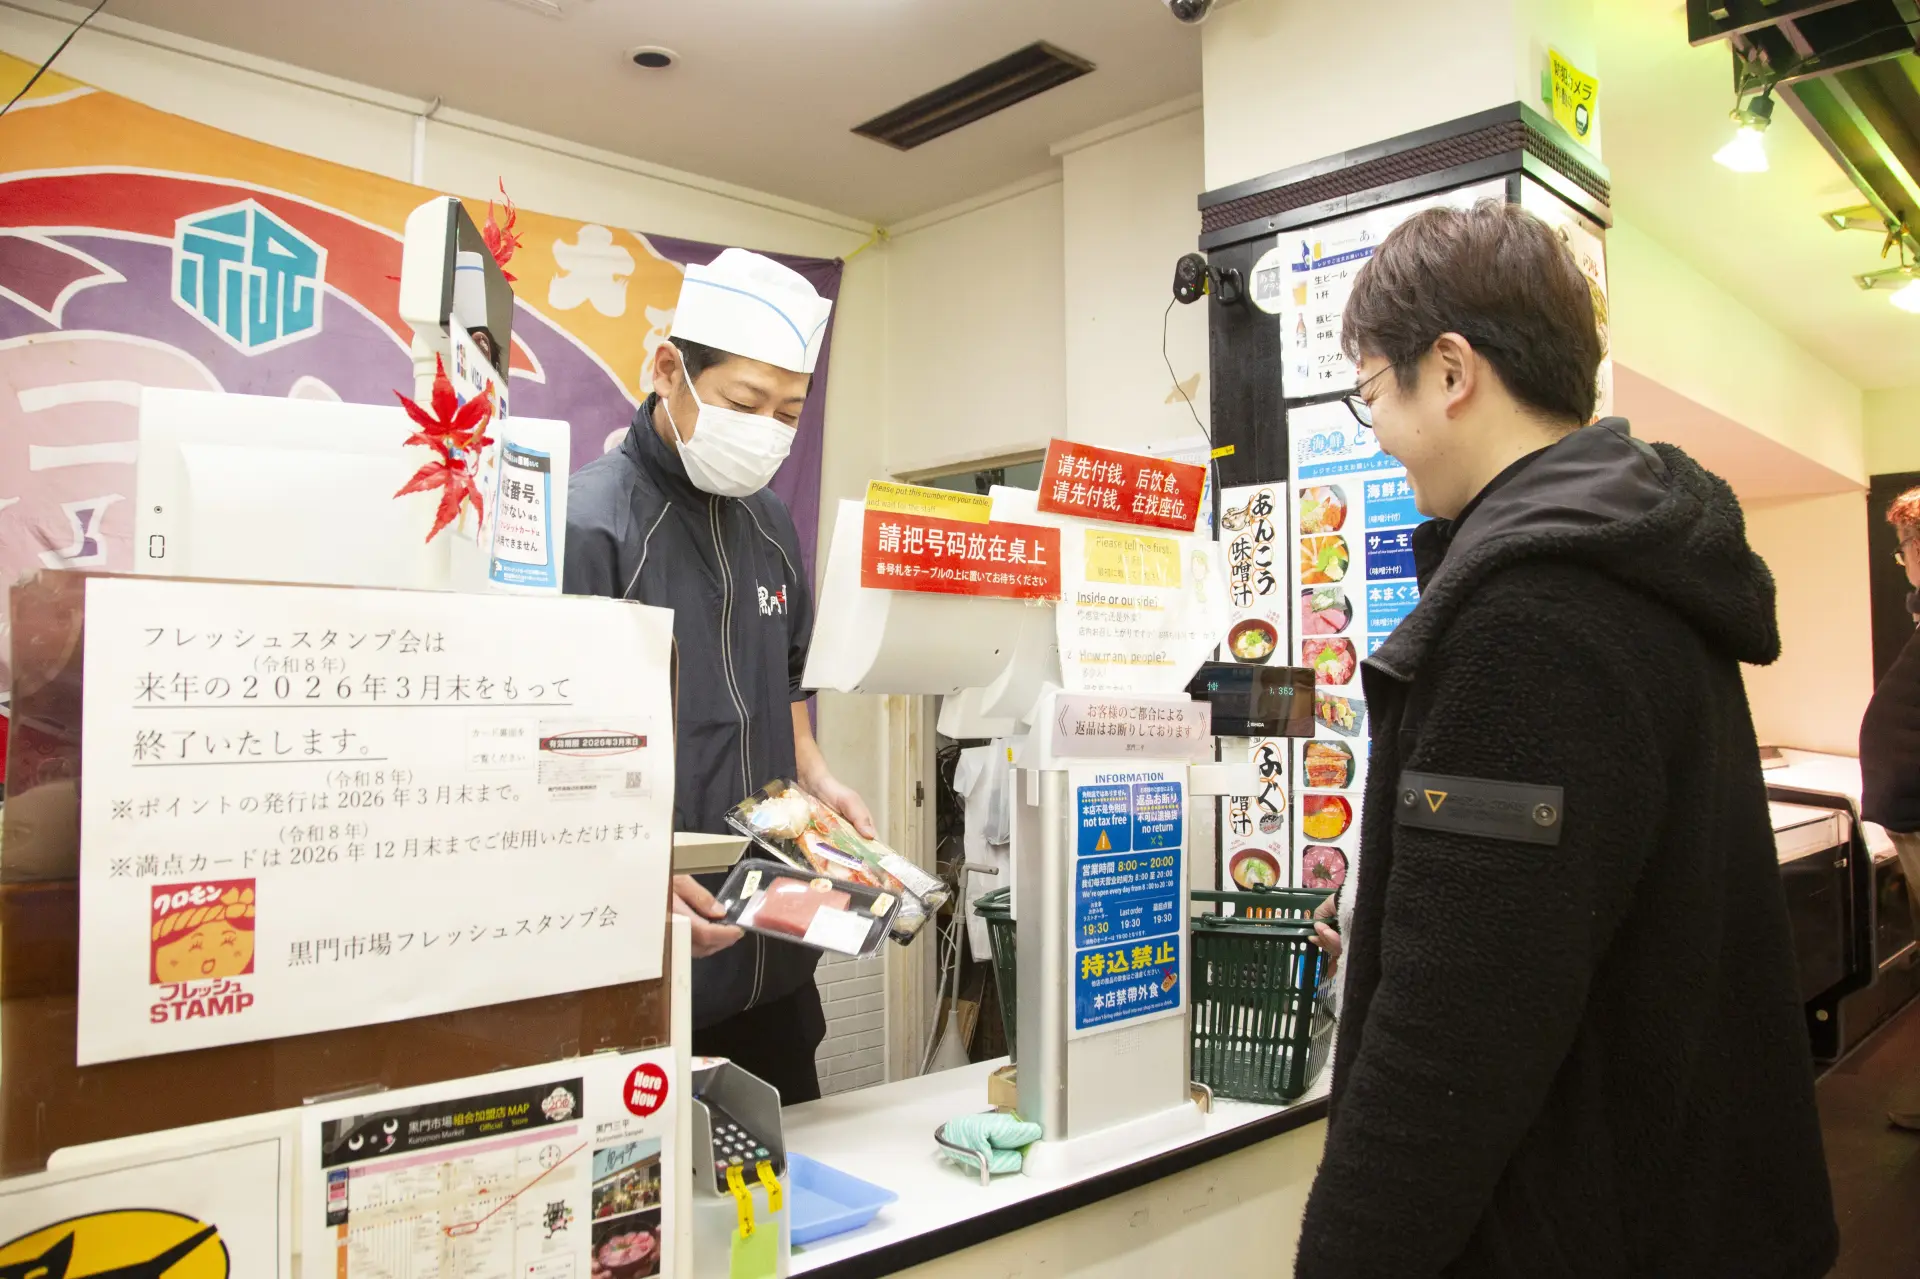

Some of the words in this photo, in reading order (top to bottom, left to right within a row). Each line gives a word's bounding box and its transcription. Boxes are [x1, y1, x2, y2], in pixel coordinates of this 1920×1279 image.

[1315, 271, 1348, 285] 生ビール
[1316, 290, 1329, 300] 1杯
[1319, 370, 1332, 379] 1本
[871, 483, 894, 493] Please
[896, 486, 908, 496] put
[908, 488, 921, 497] this
[923, 490, 946, 501] number
[957, 495, 971, 506] your
[866, 499, 880, 507] and
[881, 500, 896, 508] wait
[897, 501, 908, 509] for
[909, 502, 919, 510] the
[878, 522, 1047, 566] 請把号码放在桌上
[1096, 536, 1122, 549] Please
[1124, 538, 1137, 550] tell
[1153, 541, 1172, 554] first.
[1252, 493, 1275, 595] あんこう
[1368, 533, 1413, 550] サーモ
[876, 562, 1047, 587] 番号札をテーブルの上に置いてお待ちください
[1232, 537, 1252, 607] 味噌汁
[1369, 565, 1402, 575] (味噌汁付)
[1077, 591, 1106, 605] Inside
[1108, 595, 1118, 605] or
[144, 628, 447, 654] フレッシュスタンプ会は
[253, 655, 346, 675] (令和8年)
[1080, 651, 1100, 662] How
[1131, 651, 1167, 665] people?
[134, 672, 570, 702] 来年の2026年3月末をもって
[1087, 704, 1184, 722] お客様のご都合による
[1074, 720, 1192, 738] 返品はお断りしております
[133, 728, 369, 761] 終了いたします。
[549, 739, 580, 749] 有効期限
[582, 738, 639, 748] 2026年3月末日
[325, 770, 414, 789] (令和8年)
[1095, 772, 1164, 784] INFORMATION
[1258, 746, 1283, 813] ふぐ
[1136, 793, 1177, 806] 返品お断り
[1082, 803, 1127, 815] 本店不是免税店
[1083, 817, 1097, 827] not
[1098, 816, 1110, 826] tax
[1112, 814, 1127, 825] free
[1142, 825, 1151, 834] no
[1152, 823, 1173, 832] return
[278, 822, 369, 845] (令和8年)
[1082, 862, 1115, 877] 営業時間
[1118, 859, 1137, 872] 8:00
[1150, 856, 1174, 868] 20:00
[1135, 872, 1148, 882] 8:00
[1149, 871, 1155, 880] 至
[1157, 870, 1173, 879] 20:00
[153, 885, 222, 916] クロモン
[1082, 890, 1097, 898] We're
[1097, 889, 1109, 897] open
[1109, 887, 1122, 897] every
[1119, 908, 1130, 916] Last
[1130, 906, 1143, 915] order
[1153, 913, 1172, 924] 19:30
[1083, 921, 1109, 936] 19:30
[1120, 918, 1141, 930] 19:30
[288, 904, 618, 968] 黒門市場フレッシュスタンプ会
[1081, 941, 1176, 980] 持込禁止
[159, 978, 242, 1002] フレッシュ
[150, 992, 254, 1024] STAMP
[634, 1071, 662, 1091] Here
[631, 1090, 658, 1107] Now
[508, 1103, 530, 1116] MAP
[408, 1132, 442, 1145] Kuromon
[442, 1128, 465, 1139] Market
[479, 1120, 503, 1132] Official
[511, 1117, 529, 1127] Store
